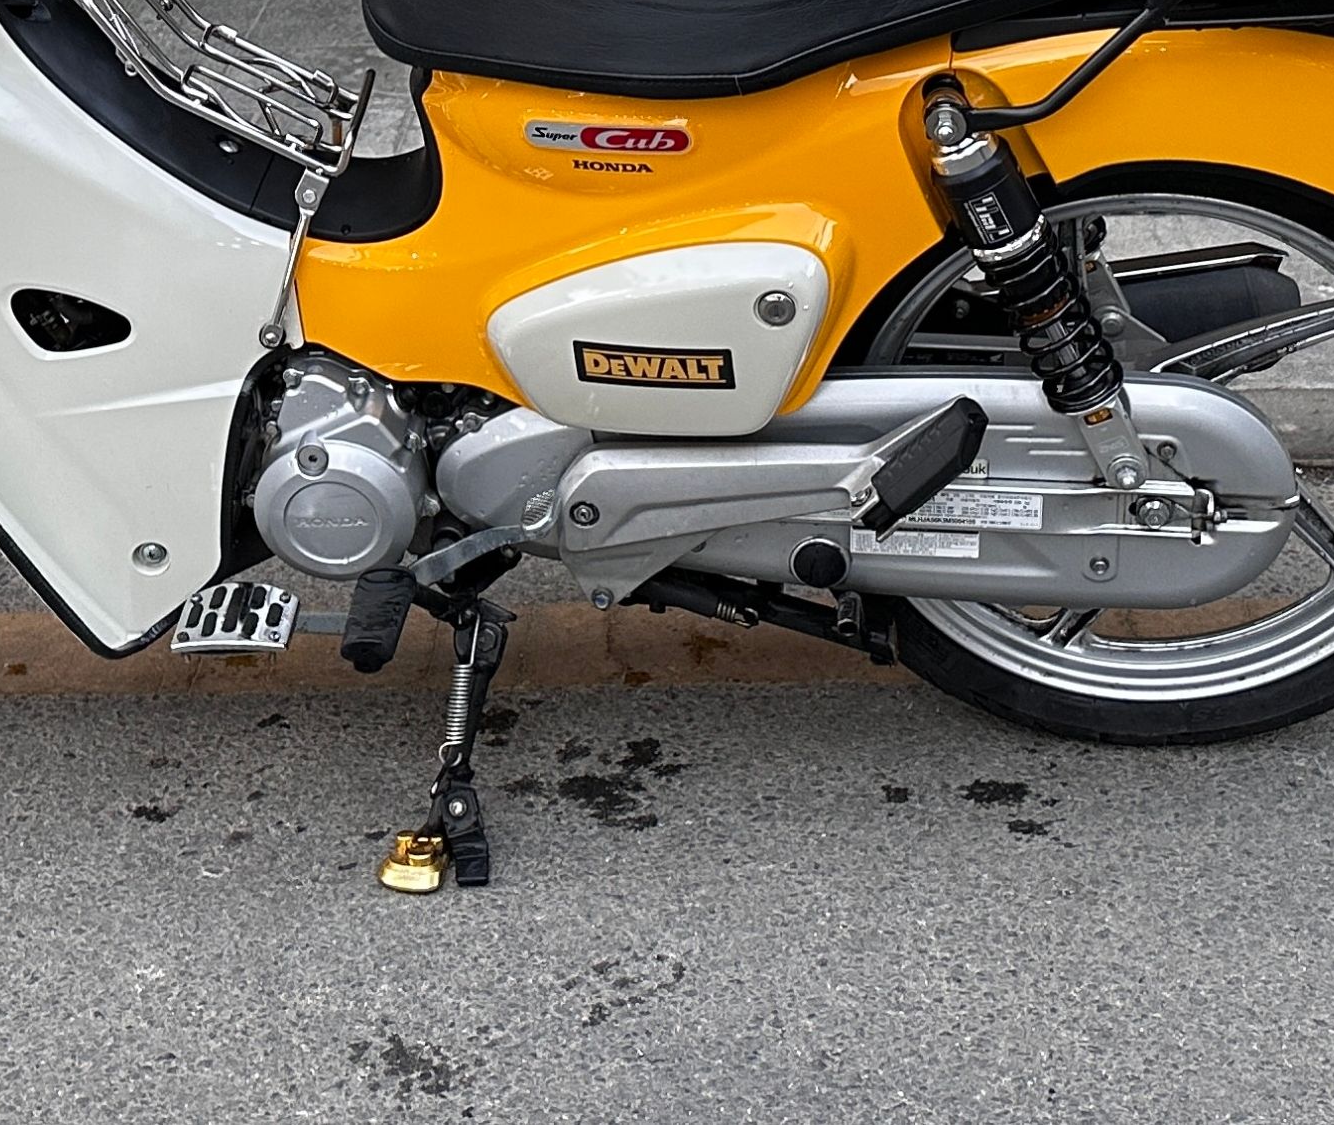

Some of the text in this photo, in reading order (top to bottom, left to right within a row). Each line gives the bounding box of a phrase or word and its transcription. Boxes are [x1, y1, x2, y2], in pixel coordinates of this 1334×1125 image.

[532, 127, 675, 150] Super Cub
[572, 159, 653, 173] HONDA
